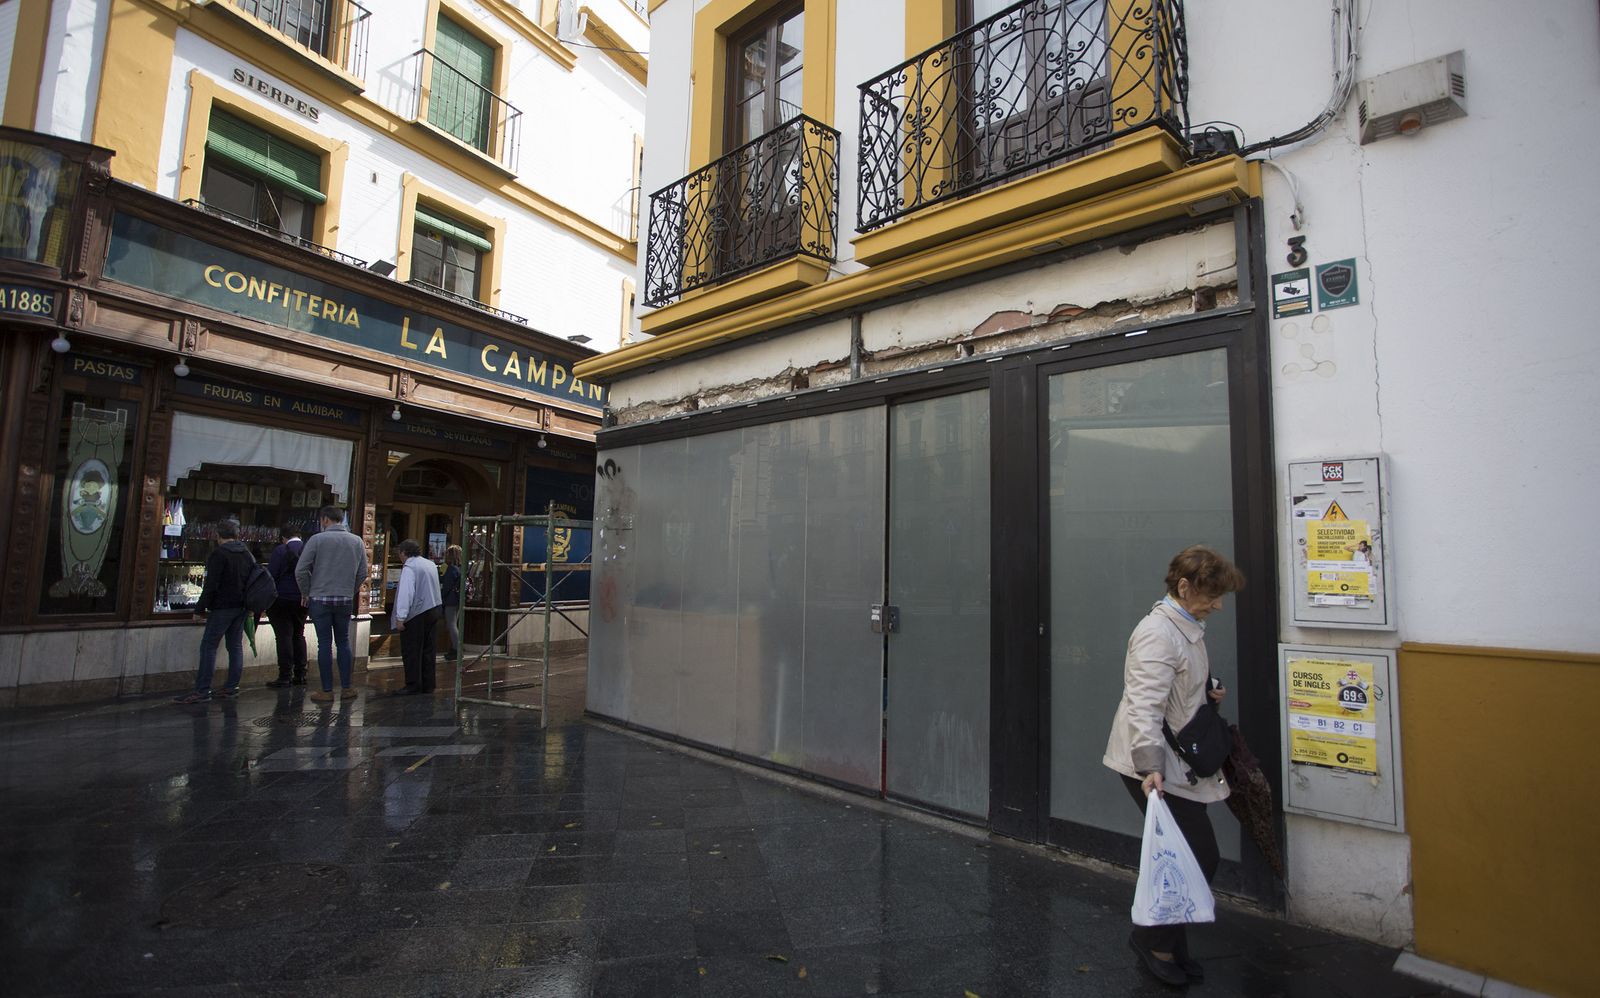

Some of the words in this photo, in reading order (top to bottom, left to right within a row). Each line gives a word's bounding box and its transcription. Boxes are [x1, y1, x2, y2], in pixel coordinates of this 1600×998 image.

[232, 67, 320, 121] SIERPES
[1286, 235, 1308, 268] 3
[203, 265, 360, 329] CONFITERIA
[400, 317, 447, 359] LA
[74, 358, 134, 380] PASTAS
[203, 383, 253, 403] FRUTAS
[263, 394, 281, 408] EN
[291, 400, 344, 420] ALMIBAR
[1292, 671, 1323, 681] CURSOS
[1293, 679, 1303, 687] DE
[1304, 680, 1331, 690] INGLÉS
[1317, 718, 1327, 727] B1
[1333, 721, 1345, 730] B2
[1353, 723, 1362, 731] C1
